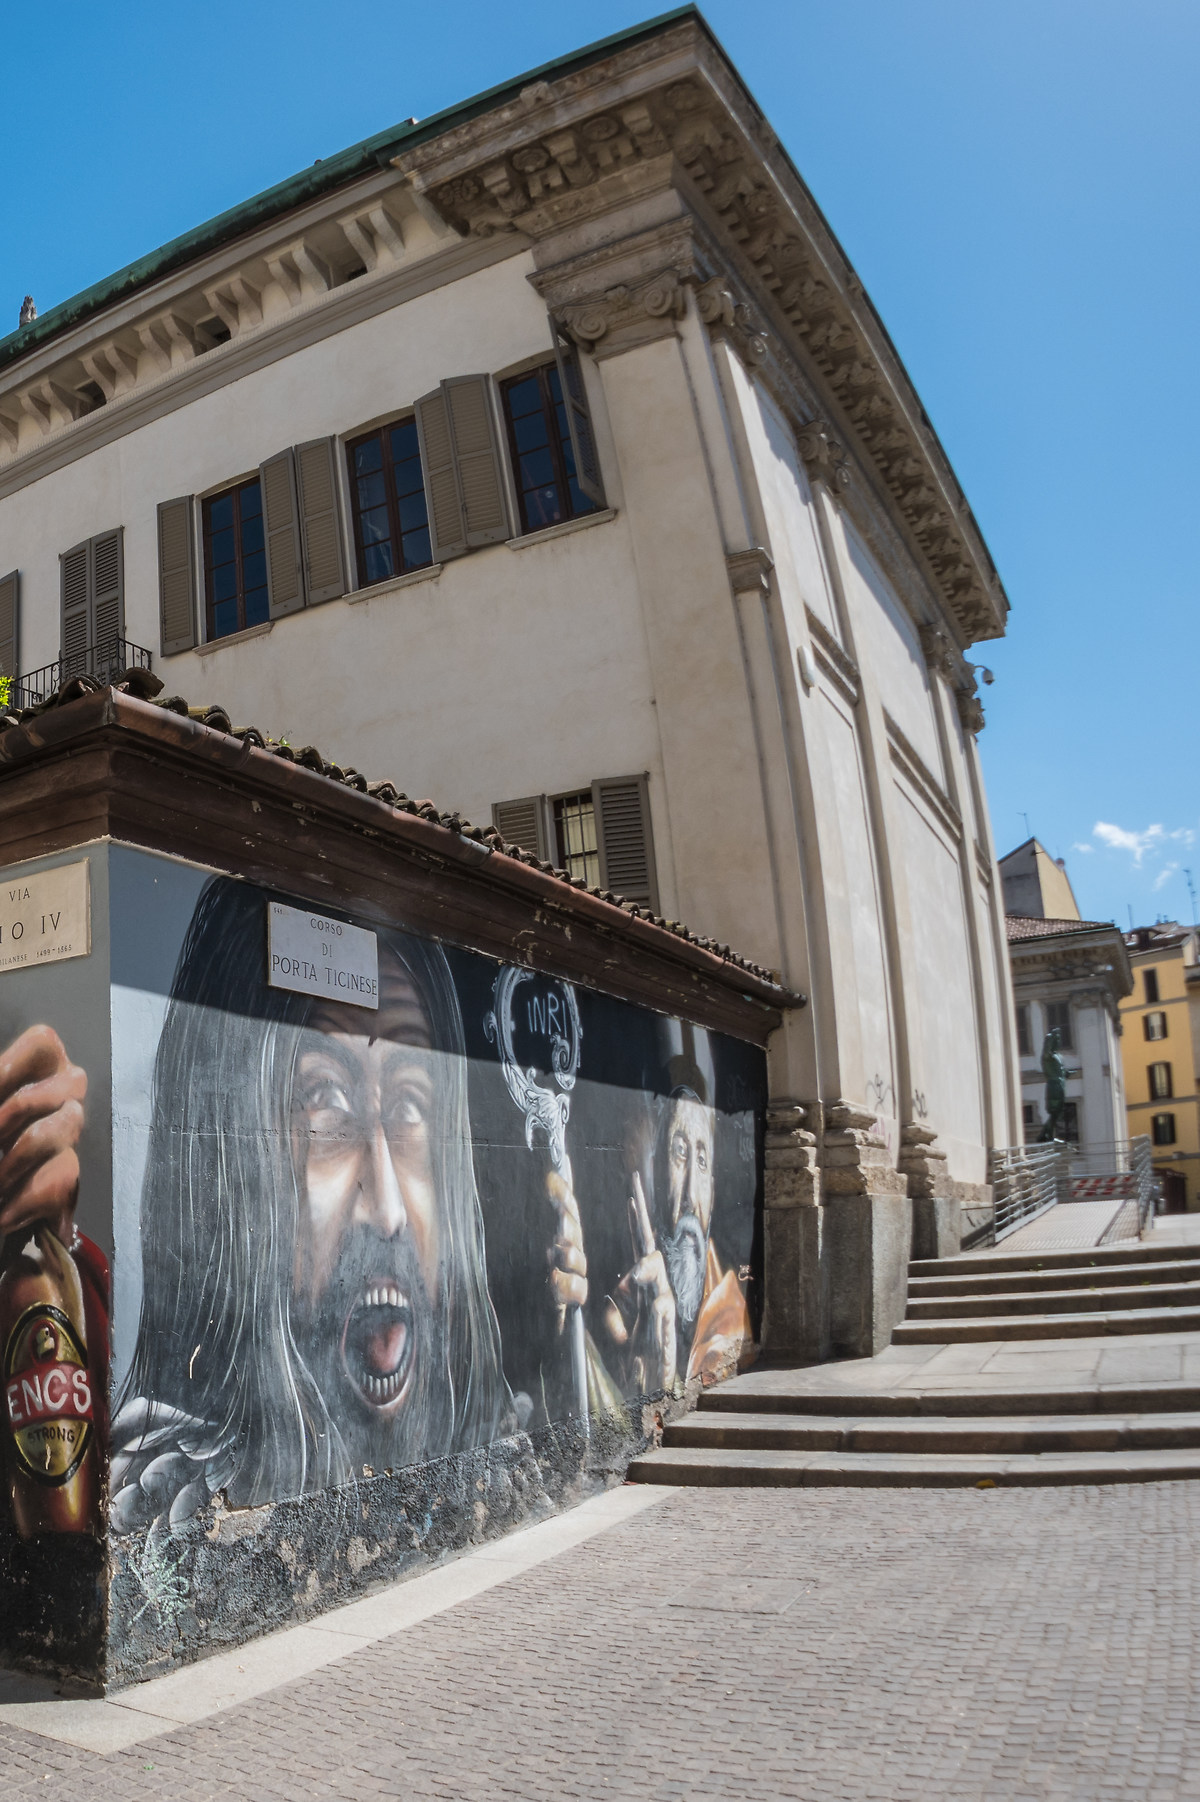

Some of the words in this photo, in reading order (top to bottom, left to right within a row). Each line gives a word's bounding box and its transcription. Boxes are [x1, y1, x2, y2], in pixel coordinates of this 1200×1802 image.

[8, 887, 31, 902] VIA
[41, 911, 61, 935] IV
[310, 918, 343, 936] CORSO
[321, 942, 333, 958] DI
[272, 954, 318, 982] PORTA
[324, 967, 378, 996] TICINESE
[527, 991, 568, 1038] INRI
[27, 1427, 75, 1443] STRONG
